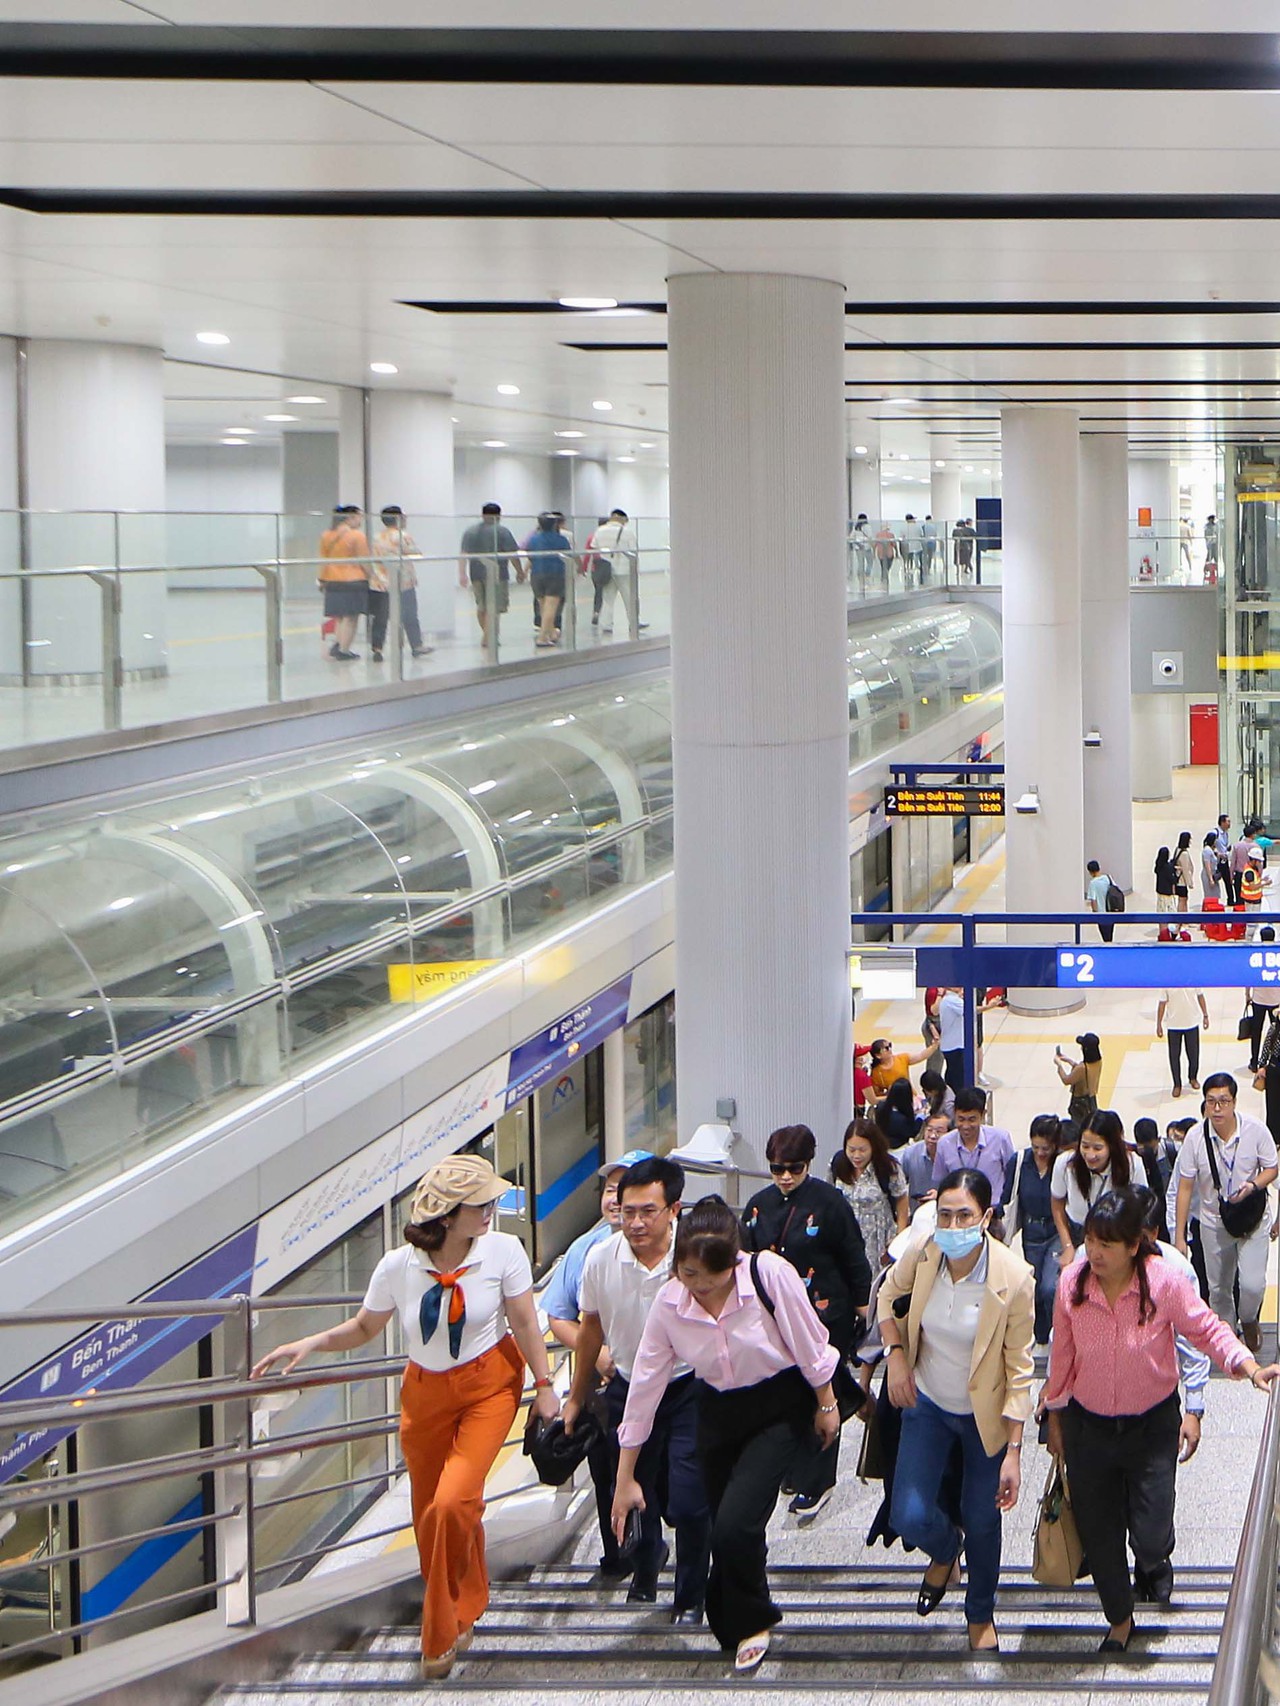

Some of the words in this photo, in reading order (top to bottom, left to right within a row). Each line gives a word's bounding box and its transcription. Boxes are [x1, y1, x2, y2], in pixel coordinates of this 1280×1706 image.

[887, 795, 897, 809] 2
[1076, 953, 1095, 982] 2
[1261, 969, 1277, 981] for
[72, 1337, 102, 1369] Bến
[82, 1357, 103, 1379] Ben
[106, 1333, 138, 1361] Thanh
